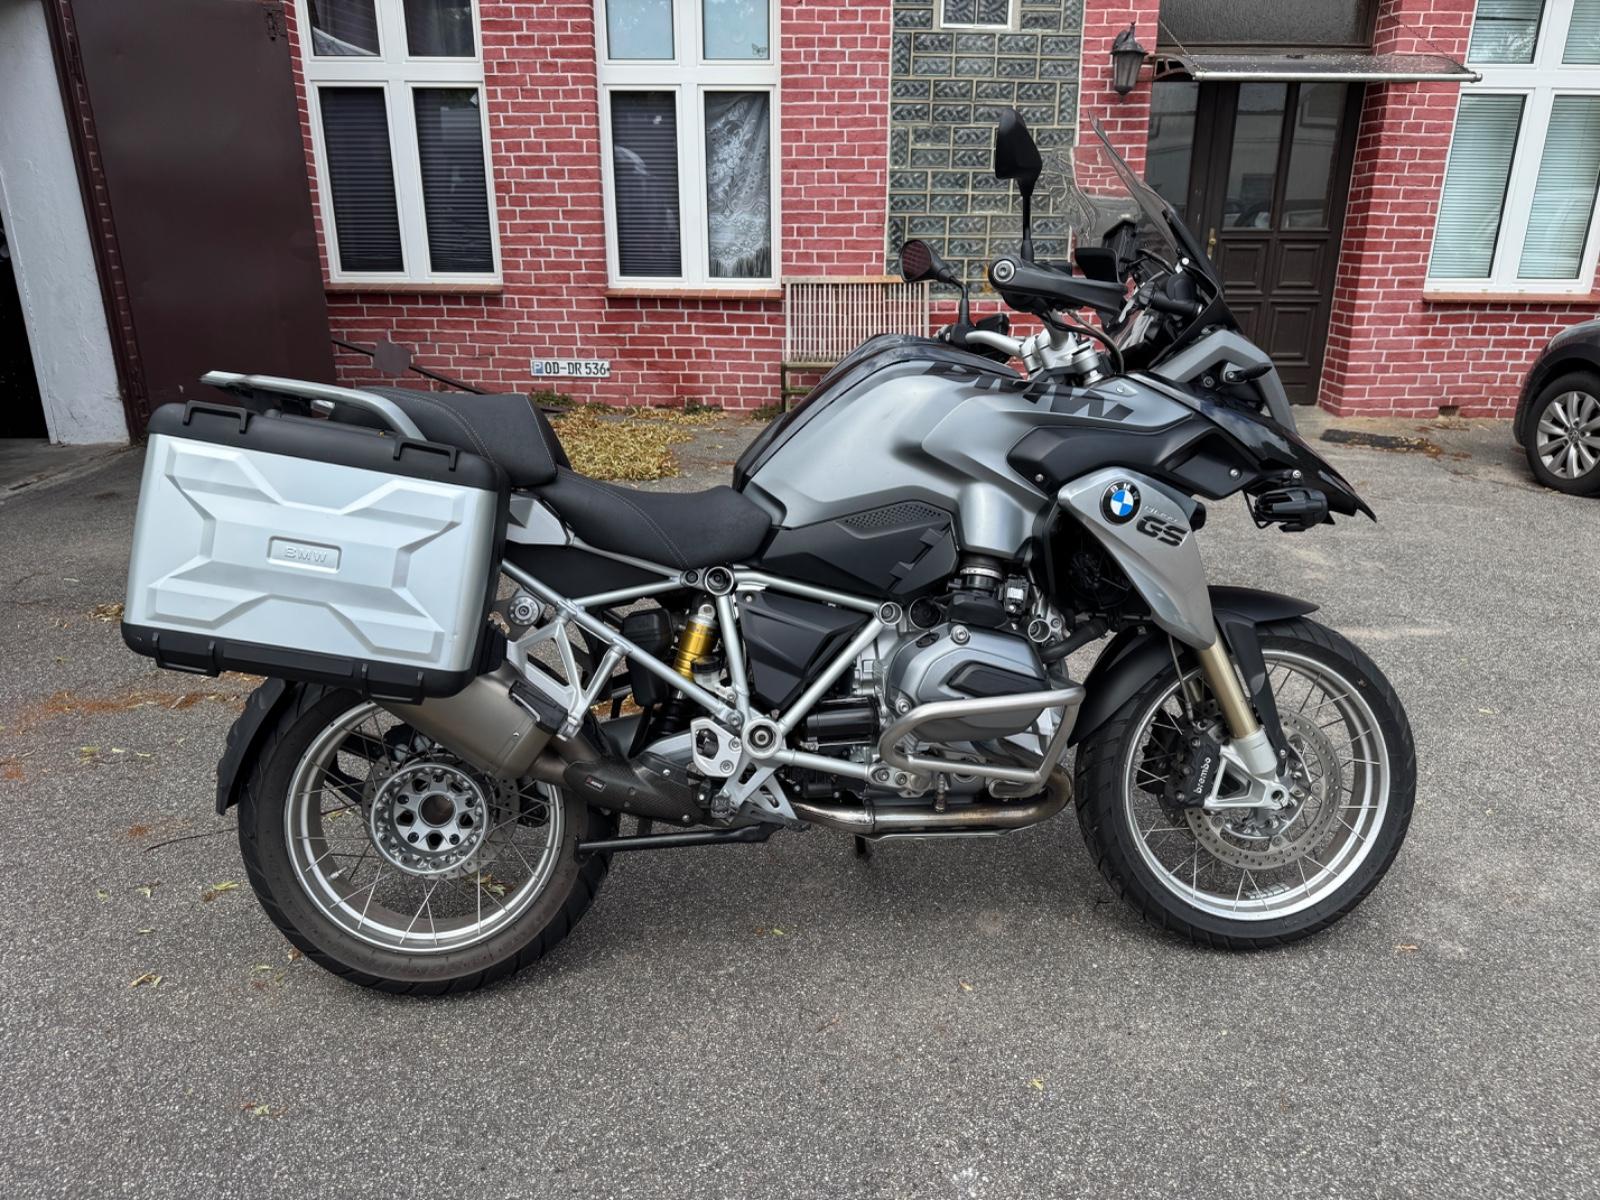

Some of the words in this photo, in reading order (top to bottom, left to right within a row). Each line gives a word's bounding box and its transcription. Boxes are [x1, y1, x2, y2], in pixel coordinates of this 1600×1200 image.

[545, 361, 582, 375] OD-DR
[584, 362, 606, 376] 536
[1136, 516, 1188, 547] GS
[284, 546, 328, 563] BMW
[1193, 756, 1212, 794] brembo
